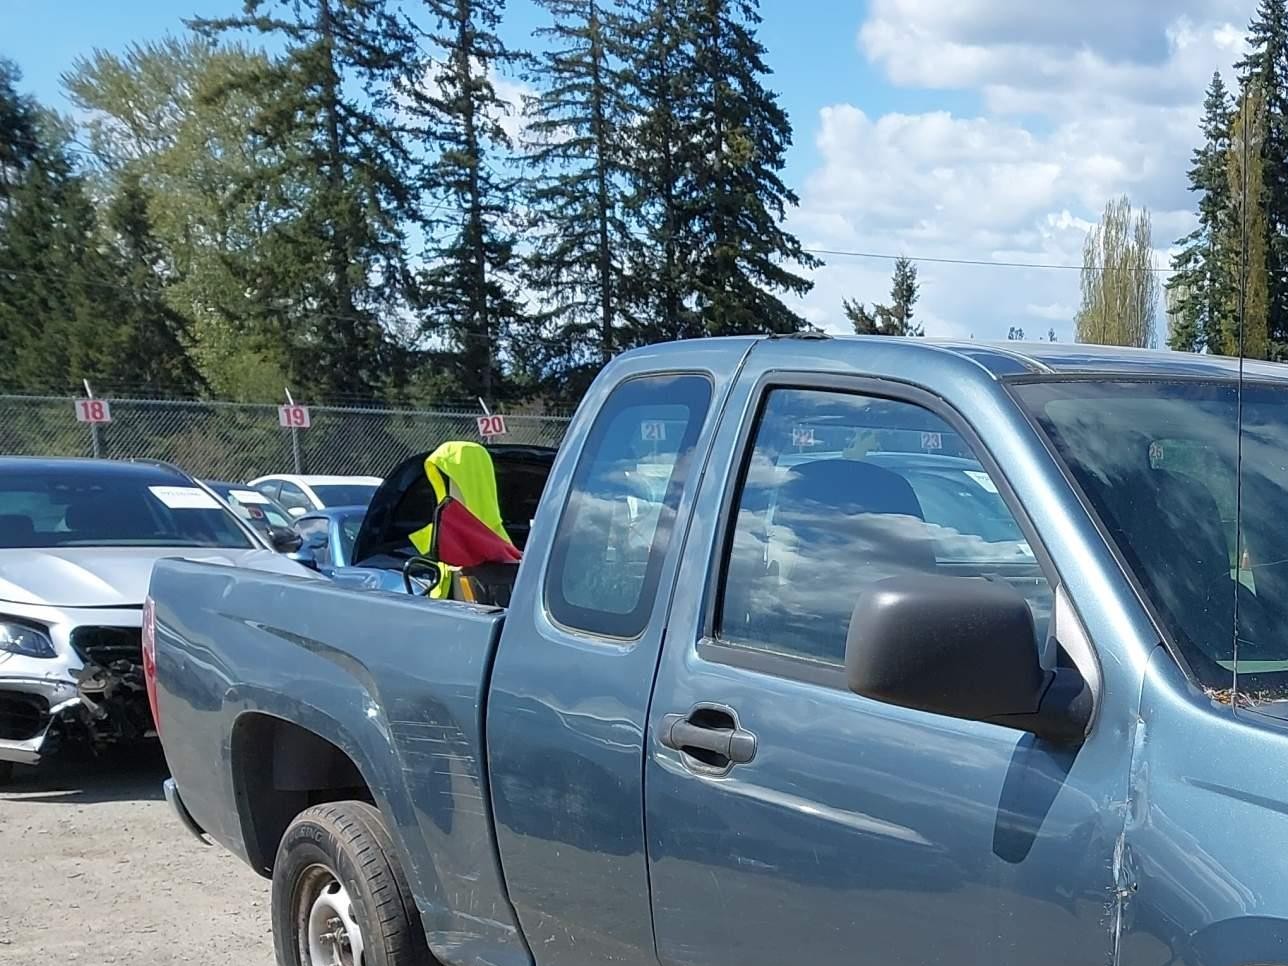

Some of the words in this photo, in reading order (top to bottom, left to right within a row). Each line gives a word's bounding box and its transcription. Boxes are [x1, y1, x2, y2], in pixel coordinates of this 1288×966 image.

[81, 401, 105, 420] 18
[284, 408, 305, 426] 19
[480, 416, 503, 434] 20
[645, 423, 661, 439] 21
